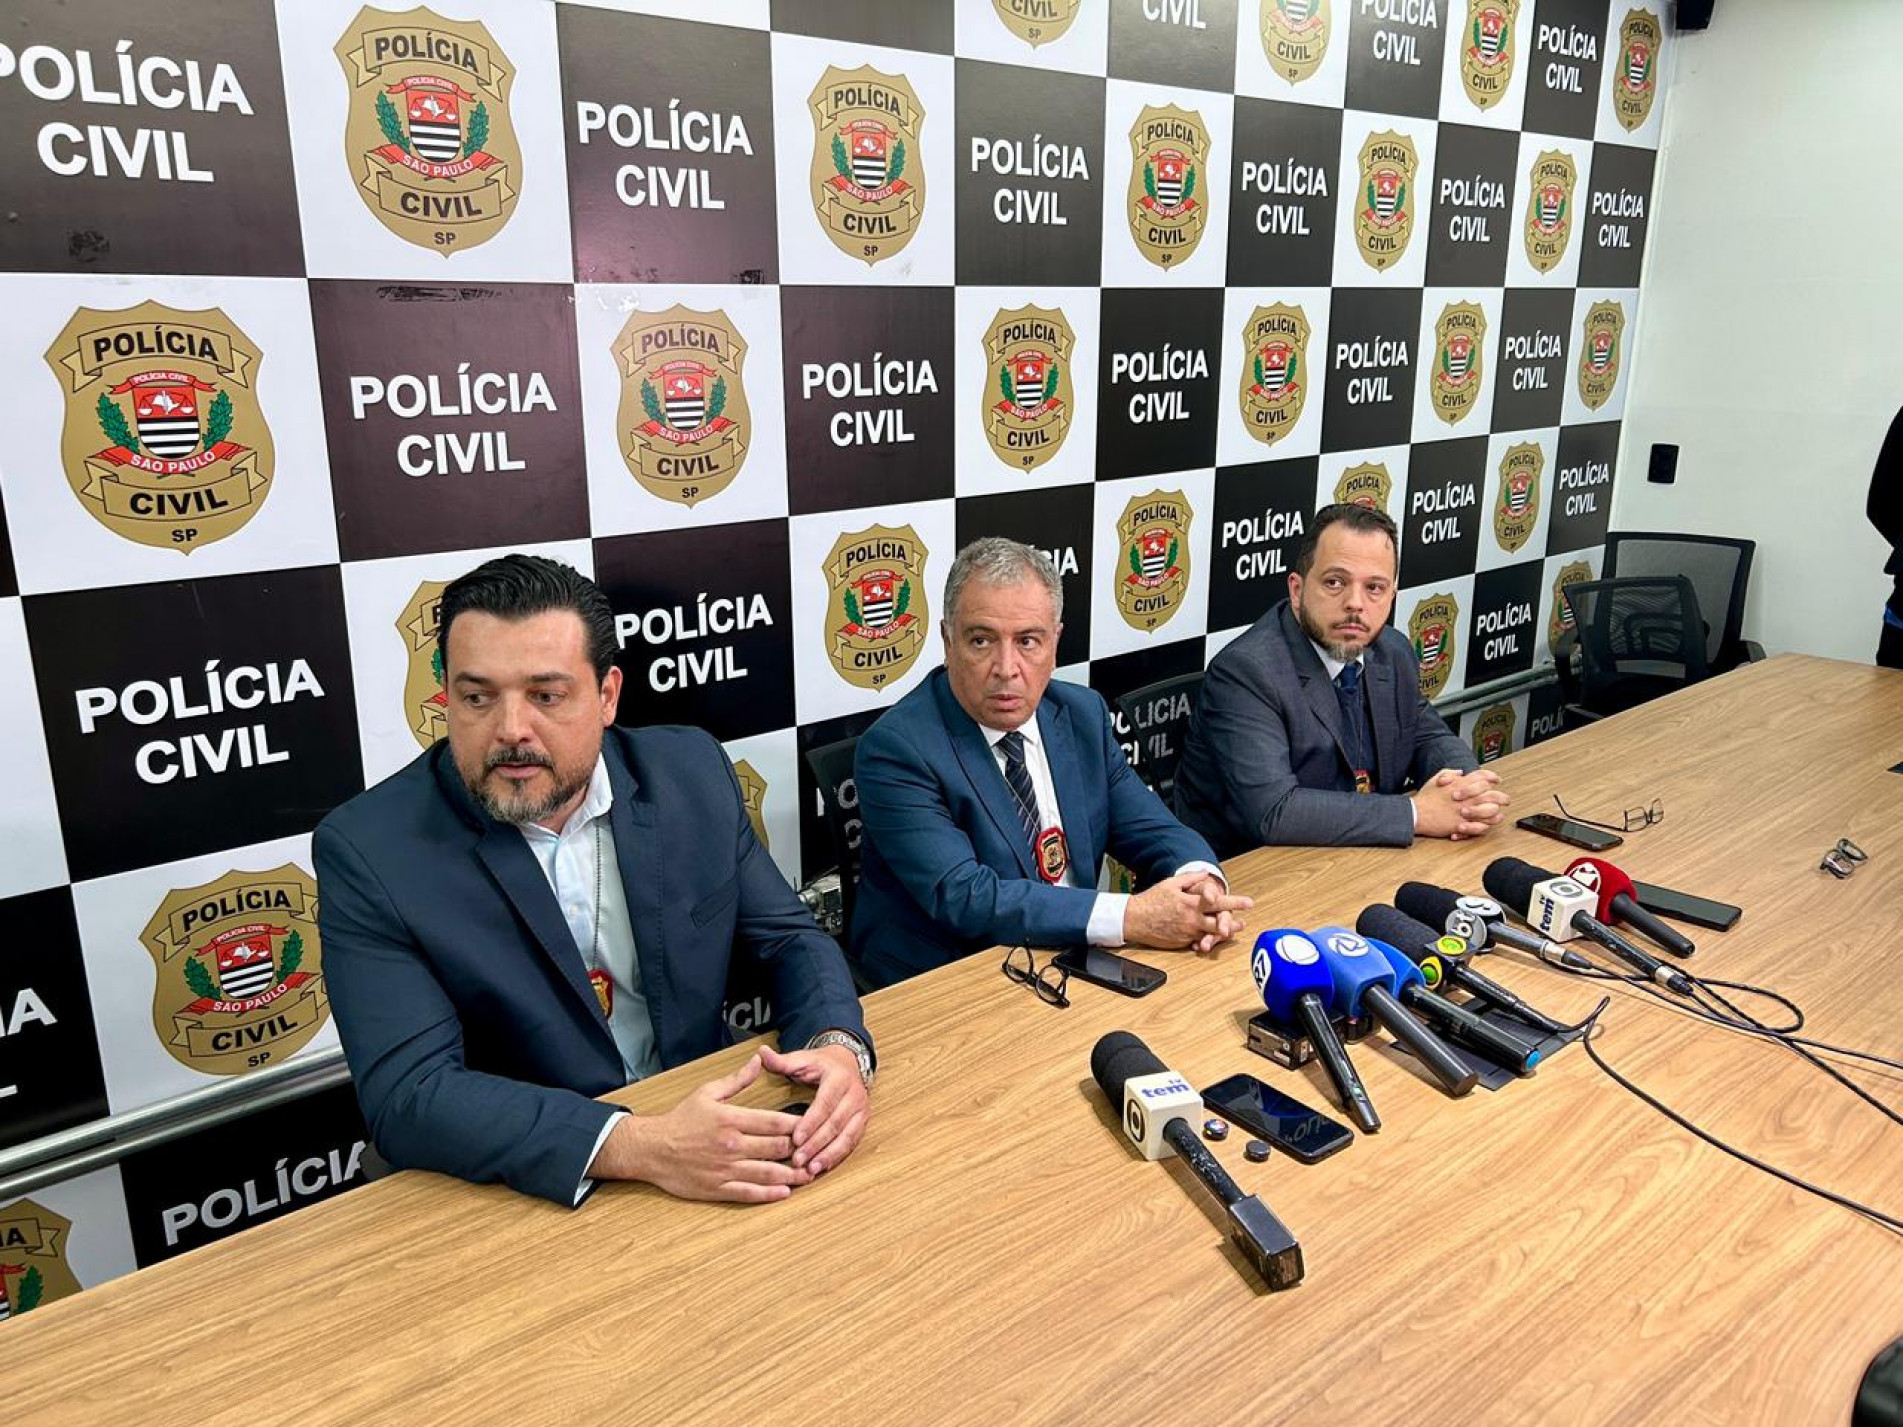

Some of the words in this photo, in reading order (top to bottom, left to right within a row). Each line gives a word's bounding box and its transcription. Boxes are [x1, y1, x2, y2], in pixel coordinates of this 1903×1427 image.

[1011, 0, 1058, 18] CIVIL
[1142, 0, 1207, 29] CIVIL
[375, 31, 479, 73] POLÍCIA
[1277, 41, 1311, 60] CIVIL
[1373, 29, 1421, 65] CIVIL
[1537, 24, 1597, 62] POLÍCIA
[1545, 62, 1583, 93] CIVIL
[834, 84, 900, 116] POLÍCIA
[576, 97, 754, 156] POLÍCIA
[36, 121, 215, 182] CIVIL
[971, 133, 1089, 180] POLÍCIA
[615, 164, 725, 209] CIVIL
[1242, 157, 1328, 197] POLÍCIA
[1440, 174, 1505, 209] POLÍCIA
[400, 191, 482, 217] CIVIL
[993, 188, 1067, 225] CIVIL
[1591, 188, 1644, 218] POLÍCIA
[843, 213, 897, 234] CIVIL
[1256, 204, 1310, 235] CIVIL
[1449, 215, 1491, 242] CIVIL
[434, 232, 456, 245] SP
[863, 245, 879, 256] SP
[1148, 228, 1186, 244] CIVIL
[1598, 223, 1631, 248] CIVIL
[93, 326, 219, 362] POLÍCIA
[641, 324, 720, 353] POLÍCIA
[1335, 335, 1409, 370] POLÍCIA
[1504, 329, 1562, 360] POLÍCIA
[802, 352, 939, 399] POLÍCIA
[1111, 343, 1209, 384] POLÍCIA
[1512, 366, 1549, 391] CIVIL
[350, 362, 558, 419] POLÍCIA
[1347, 376, 1393, 404] CIVIL
[1129, 390, 1190, 424] CIVIL
[830, 409, 915, 447] CIVIL
[1007, 429, 1050, 447] CIVIL
[397, 431, 526, 477] CIVIL
[657, 455, 719, 476] CIVIL
[1559, 460, 1610, 490] POLÍCIA
[130, 488, 228, 515] CIVIL
[681, 487, 698, 498] SP
[1412, 481, 1476, 515] POLÍCIA
[1565, 492, 1597, 517] CIVIL
[171, 529, 198, 542] SP
[1221, 508, 1305, 548] POLÍCIA
[1421, 516, 1461, 545] CIVIL
[846, 540, 907, 568] POLÍCIA
[1236, 548, 1287, 581] CIVIL
[1134, 594, 1170, 612] CIVIL
[614, 592, 774, 649] POLÍCIA
[1476, 602, 1532, 639] POLÍCIA
[854, 646, 903, 667] CIVIL
[1484, 637, 1519, 661] CIVIL
[649, 646, 748, 692] CIVIL
[75, 659, 325, 734] POLÍCIA
[135, 724, 290, 784] CIVIL
[183, 889, 292, 932] POLÍCIA
[1539, 897, 1555, 932] tem
[212, 1015, 298, 1051] CIVIL
[247, 1052, 271, 1067] SP
[1141, 1084, 1190, 1098] tem
